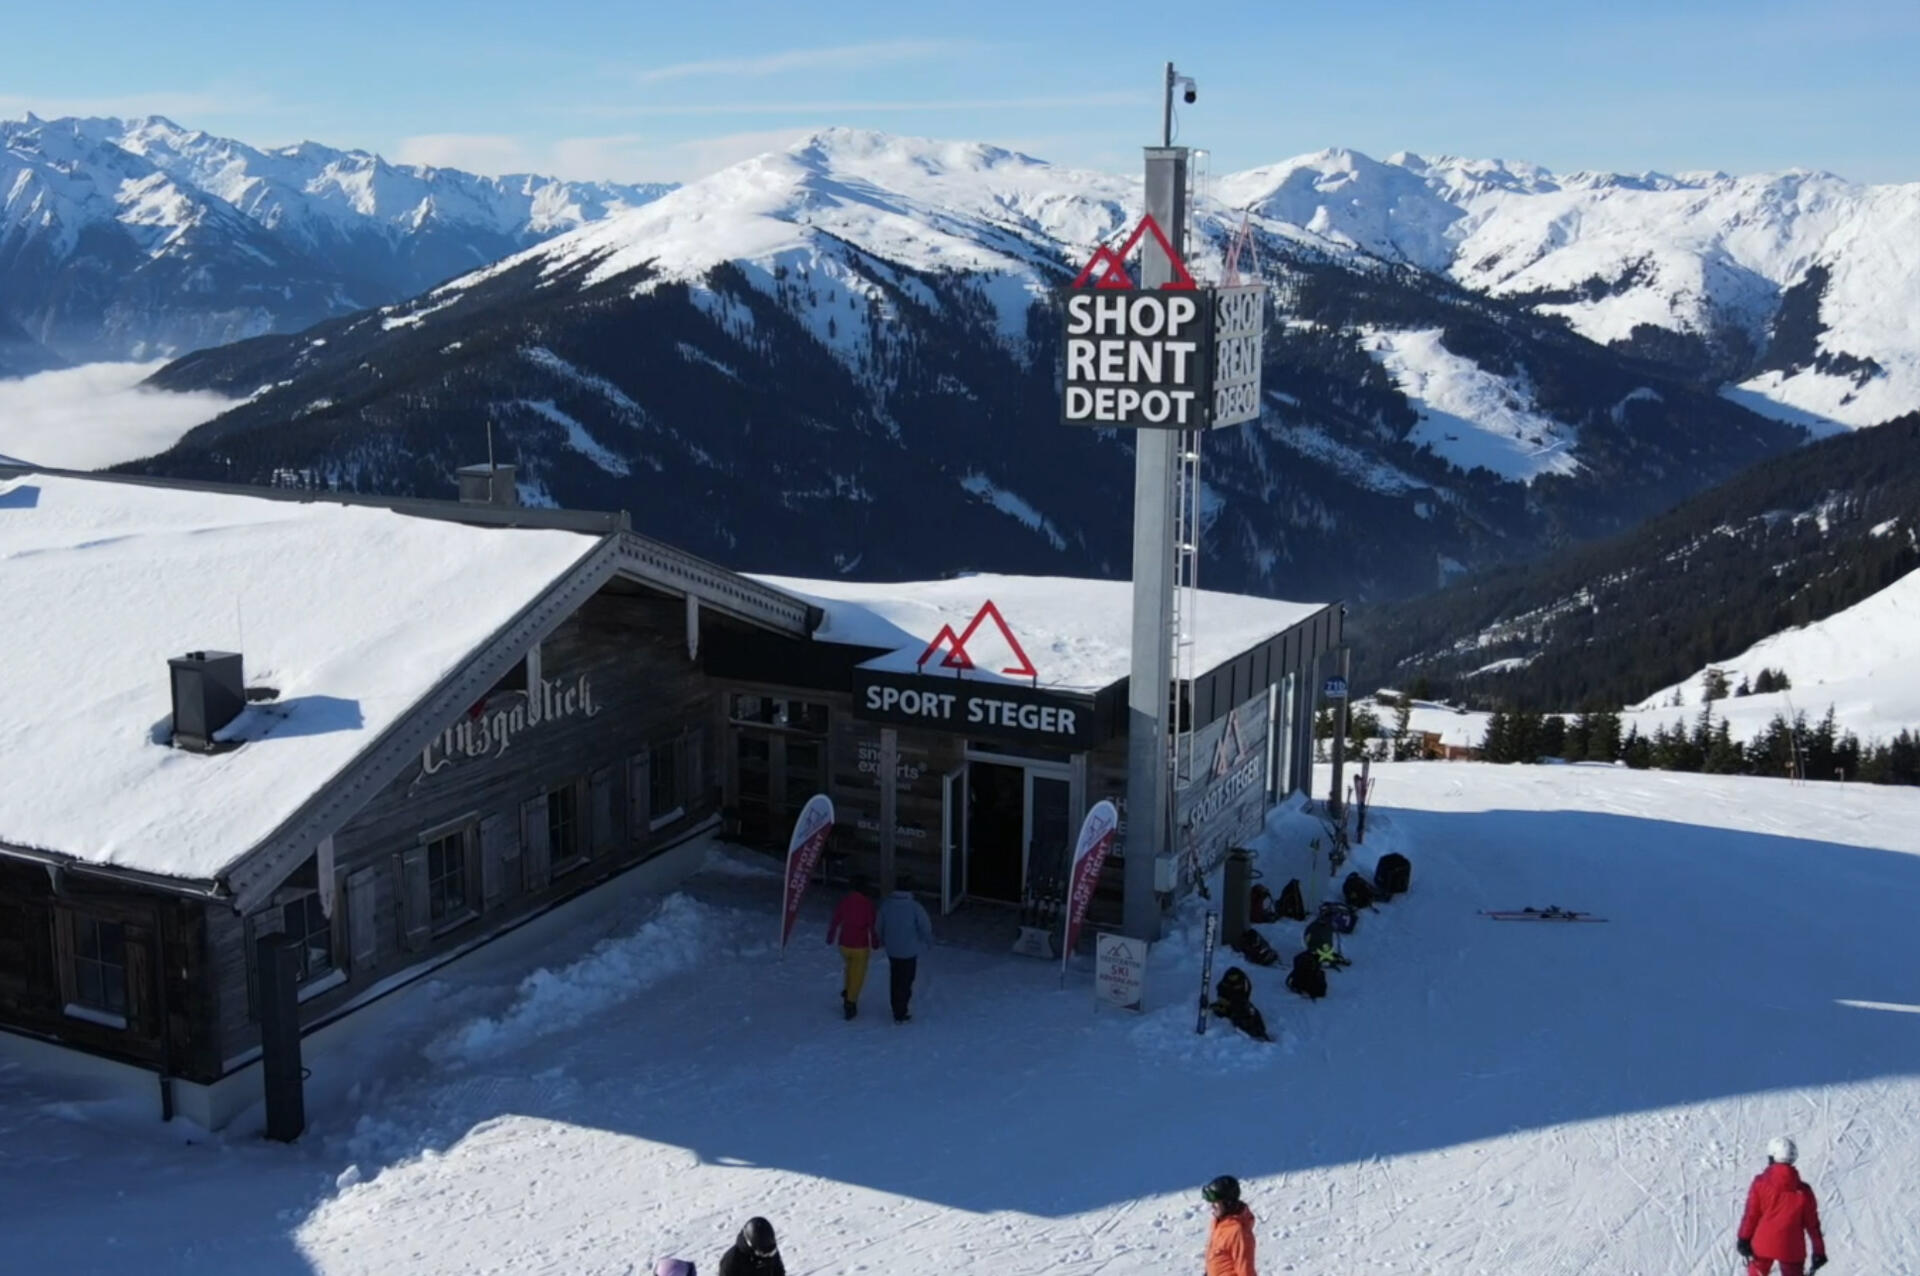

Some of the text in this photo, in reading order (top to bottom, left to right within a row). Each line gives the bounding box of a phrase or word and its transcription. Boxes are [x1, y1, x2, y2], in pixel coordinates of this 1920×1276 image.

[1066, 294, 1197, 338] SHOP
[1218, 292, 1262, 334] SHOP
[1066, 339, 1197, 385] RENT
[1217, 335, 1260, 381] RENT
[1065, 386, 1195, 424] DEPOT
[1215, 382, 1258, 421] DEPOT
[866, 684, 1077, 735] SPORT STEGER
[857, 760, 919, 780] exrts
[1190, 755, 1261, 834] SPORT STEGER
[856, 820, 928, 839] BLIARD
[1073, 852, 1095, 901] DEPOT
[1111, 964, 1129, 977] SKI
